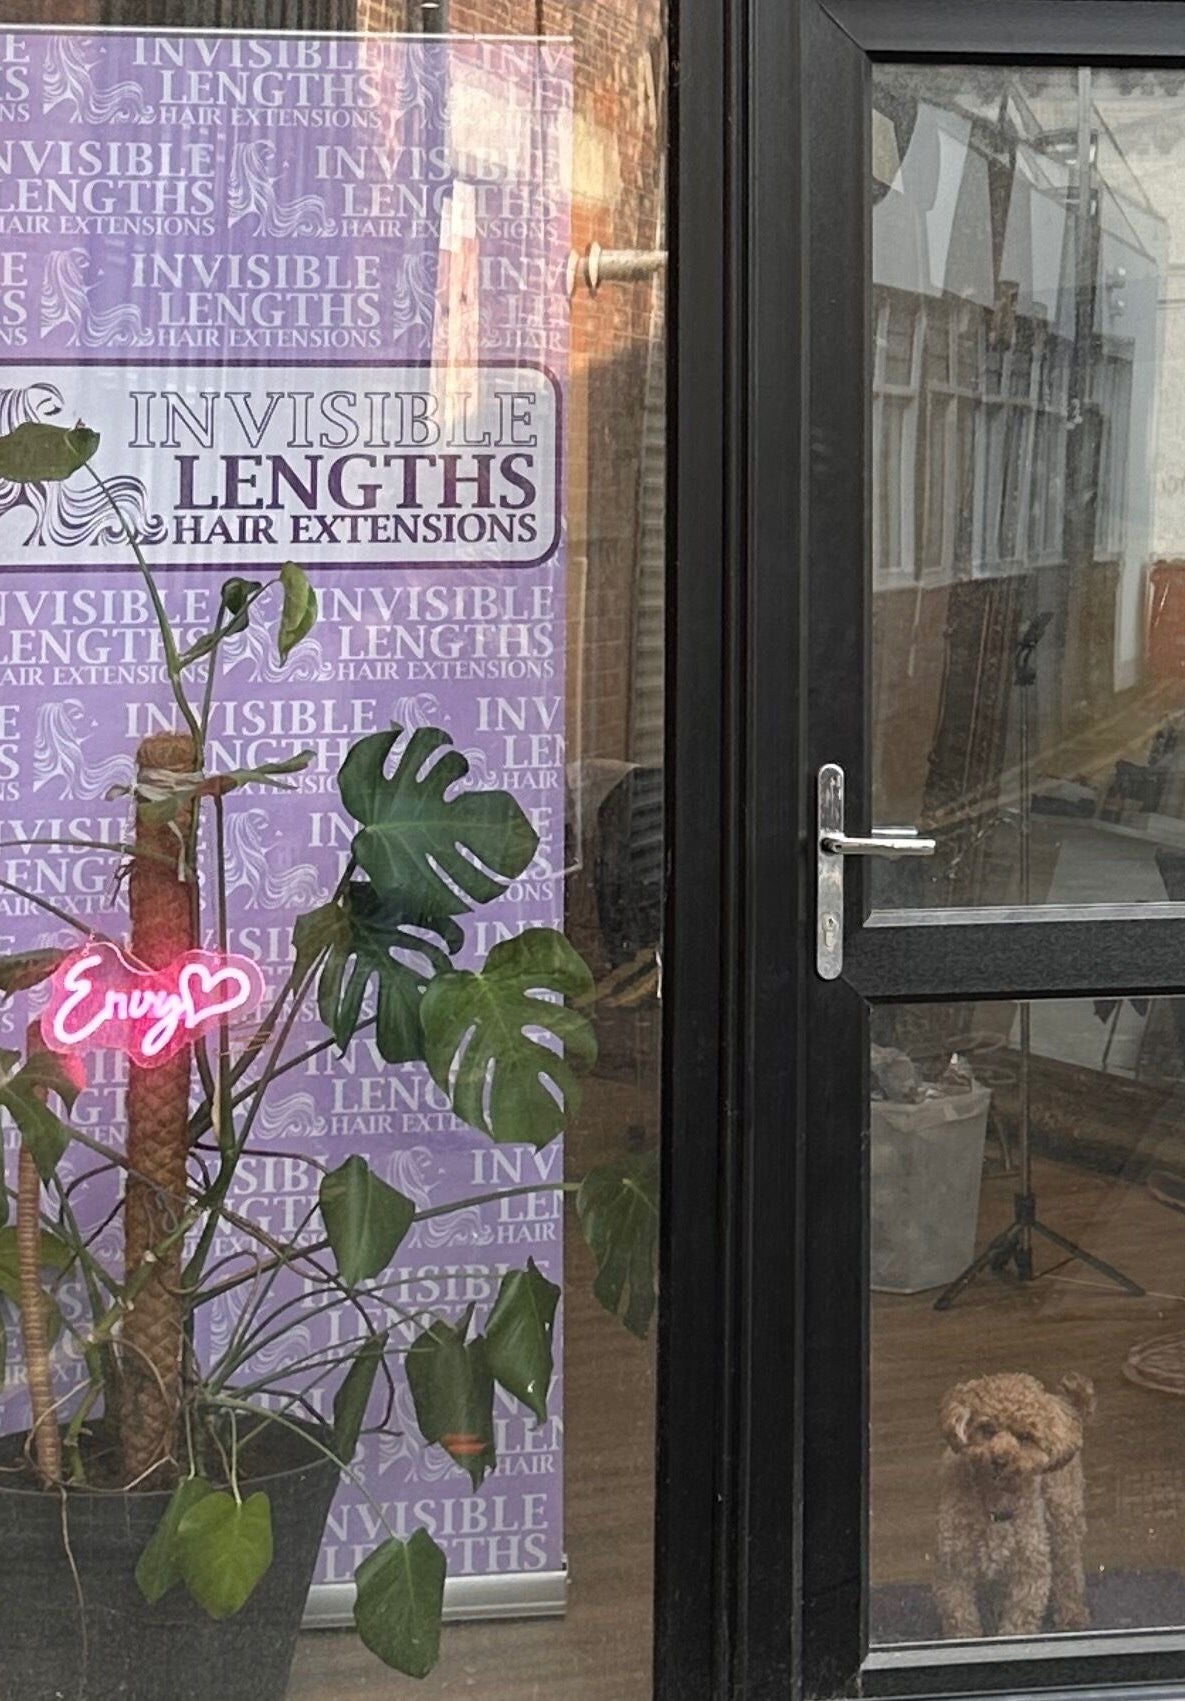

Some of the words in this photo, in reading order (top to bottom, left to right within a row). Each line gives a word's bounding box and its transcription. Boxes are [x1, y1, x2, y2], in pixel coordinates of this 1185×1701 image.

[132, 37, 382, 70] INVISIBLE
[160, 70, 381, 107] LENGTHS
[160, 106, 222, 125] HAIR
[231, 108, 382, 128] EXTENSIONS
[60, 216, 215, 236] EXTENSIONS
[341, 219, 402, 238] HAIR
[131, 253, 381, 289] INVISIBLE
[158, 291, 381, 327] LENGTHS
[158, 328, 220, 347] HAIR
[230, 328, 382, 348] EXTENSIONS
[128, 390, 538, 449] INVISIBLE
[173, 453, 537, 511] LENGTHS
[171, 514, 278, 546] HAIR
[290, 513, 538, 544] EXTENSIONS
[316, 585, 554, 622] INVISIBLE
[338, 622, 554, 660] LENGTHS
[337, 661, 399, 681] HAIR
[407, 659, 554, 680] EXTENSIONS
[502, 770, 558, 790] HAIR
[53, 954, 187, 1057] Envy
[330, 1114, 393, 1136] HAIR
[496, 1223, 556, 1245] HAIR
[494, 1453, 555, 1478] HAIR
